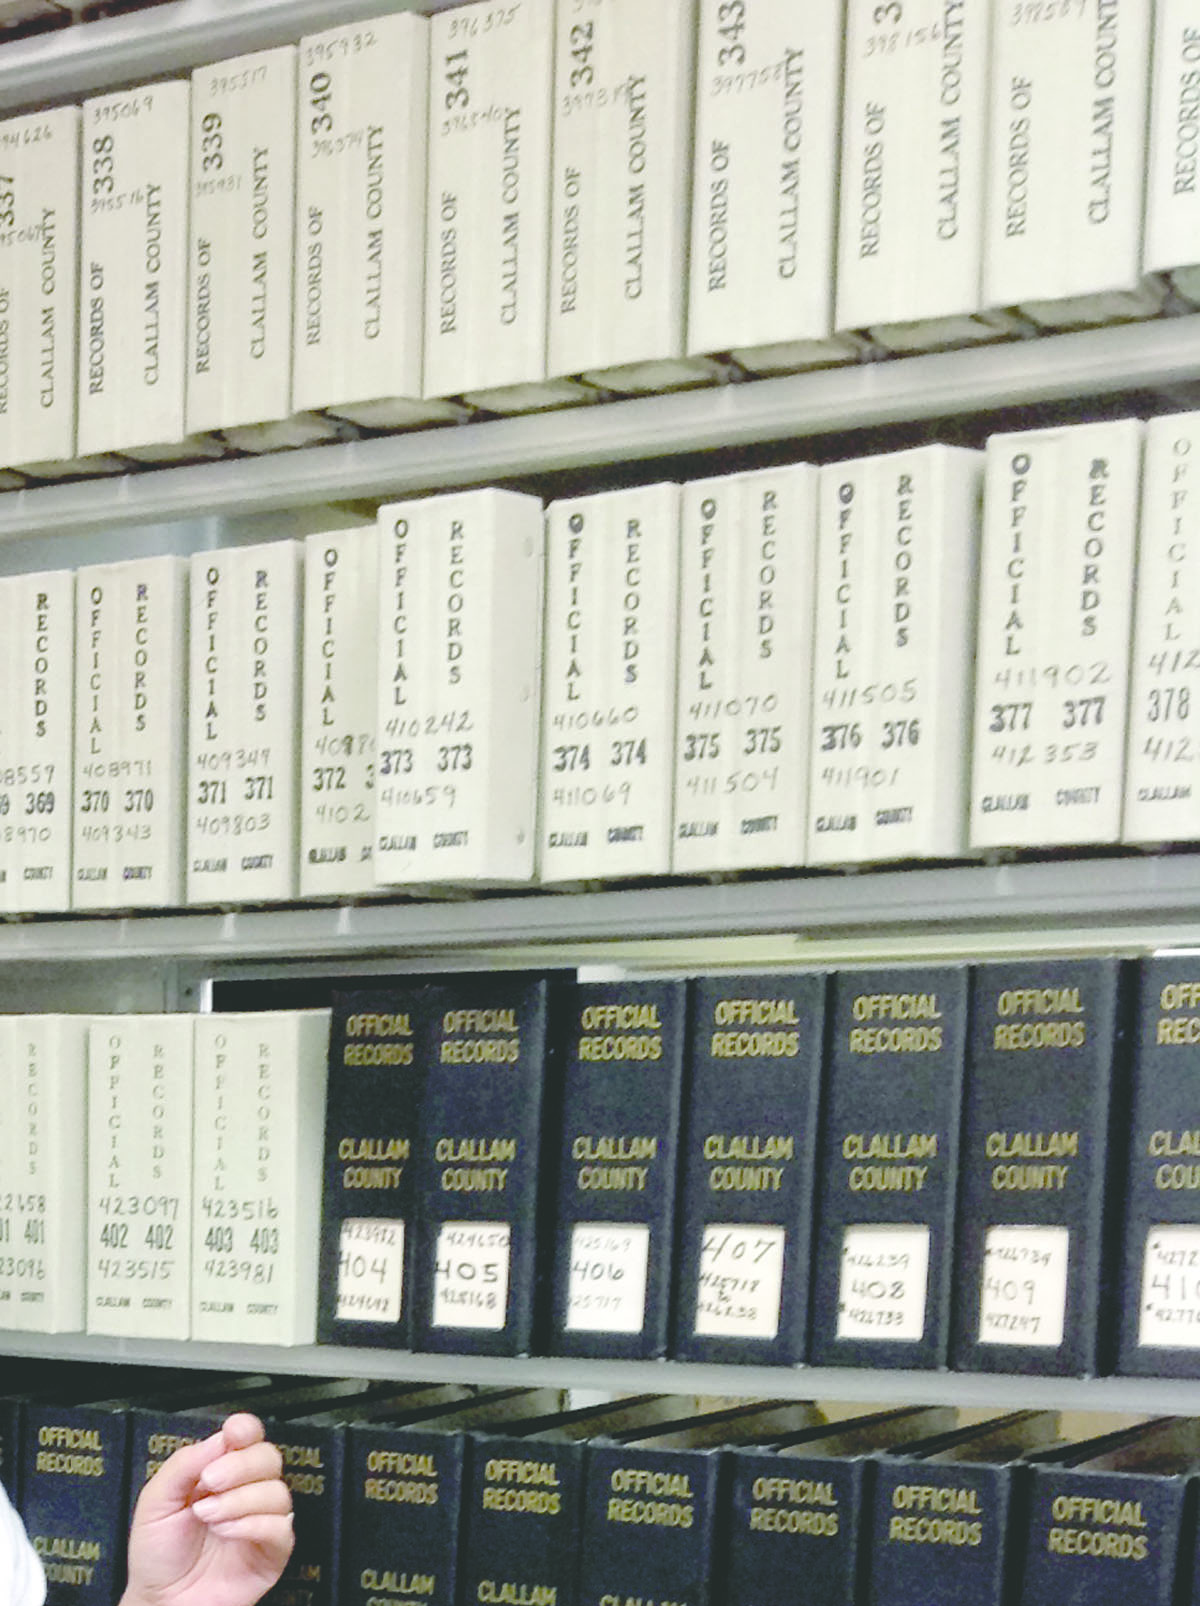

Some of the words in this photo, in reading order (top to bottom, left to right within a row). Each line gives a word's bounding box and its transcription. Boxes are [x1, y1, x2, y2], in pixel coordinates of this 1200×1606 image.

[715, 0, 747, 68] 343
[569, 21, 595, 89] 342
[444, 48, 471, 110] 341
[310, 72, 333, 132] 340
[780, 48, 805, 150] COUNTY
[203, 113, 224, 171] 339
[711, 140, 730, 171] OF
[91, 135, 115, 195] 338
[146, 183, 164, 272] COUNTY
[778, 158, 800, 279] CLALLAM
[709, 178, 729, 292] RECORDS
[90, 261, 105, 290] OF
[89, 297, 107, 396] RECORDS
[144, 282, 160, 386] CLALLAM
[1005, 454, 1031, 656] OFFICIAL
[1081, 458, 1107, 637] RECORDS
[392, 519, 409, 707] OFFICIAL
[448, 520, 464, 686] RECORDS
[995, 662, 1113, 689] 411902
[687, 692, 778, 719] 411070
[823, 680, 918, 707] 411505
[1148, 688, 1189, 721] 378
[384, 711, 474, 736] 410242
[990, 703, 1032, 732] 377
[1062, 697, 1106, 728] 377
[685, 733, 720, 760] 375
[744, 727, 782, 754] 375
[822, 725, 861, 750] 376
[882, 719, 919, 748] 376
[380, 750, 413, 774] 373
[438, 744, 472, 772] 373
[553, 746, 591, 771] 374
[610, 739, 647, 766] 374
[197, 779, 228, 804] 371
[244, 775, 274, 800] 371
[685, 768, 778, 796] 411504
[82, 789, 110, 812] 370
[124, 788, 154, 812] 370
[714, 1000, 796, 1027] OFFICIAL
[998, 989, 1083, 1017] OFFICIAL
[711, 1029, 798, 1056] RECORDS
[994, 1021, 1085, 1048] RECORDS
[703, 1134, 792, 1160] CLALLAM
[986, 1132, 1078, 1159] CLALLAM
[709, 1164, 783, 1190] COUNTY
[991, 1163, 1069, 1190] COUNTY
[99, 1197, 179, 1217] 423097
[100, 1224, 129, 1247] 402
[144, 1224, 173, 1250] 402
[205, 1228, 232, 1252] 403
[251, 1229, 279, 1254] 403
[701, 1236, 774, 1262] 407
[98, 1260, 172, 1279] 423515
[851, 1278, 906, 1299] 408
[984, 1278, 1036, 1304] 409
[368, 1450, 439, 1477] OFFICIAL
[366, 1479, 439, 1506] RECORDS
[1052, 1495, 1146, 1527] OFFICIAL
[1048, 1528, 1147, 1560] RECORDS
[361, 1570, 435, 1597] CLALLAM
